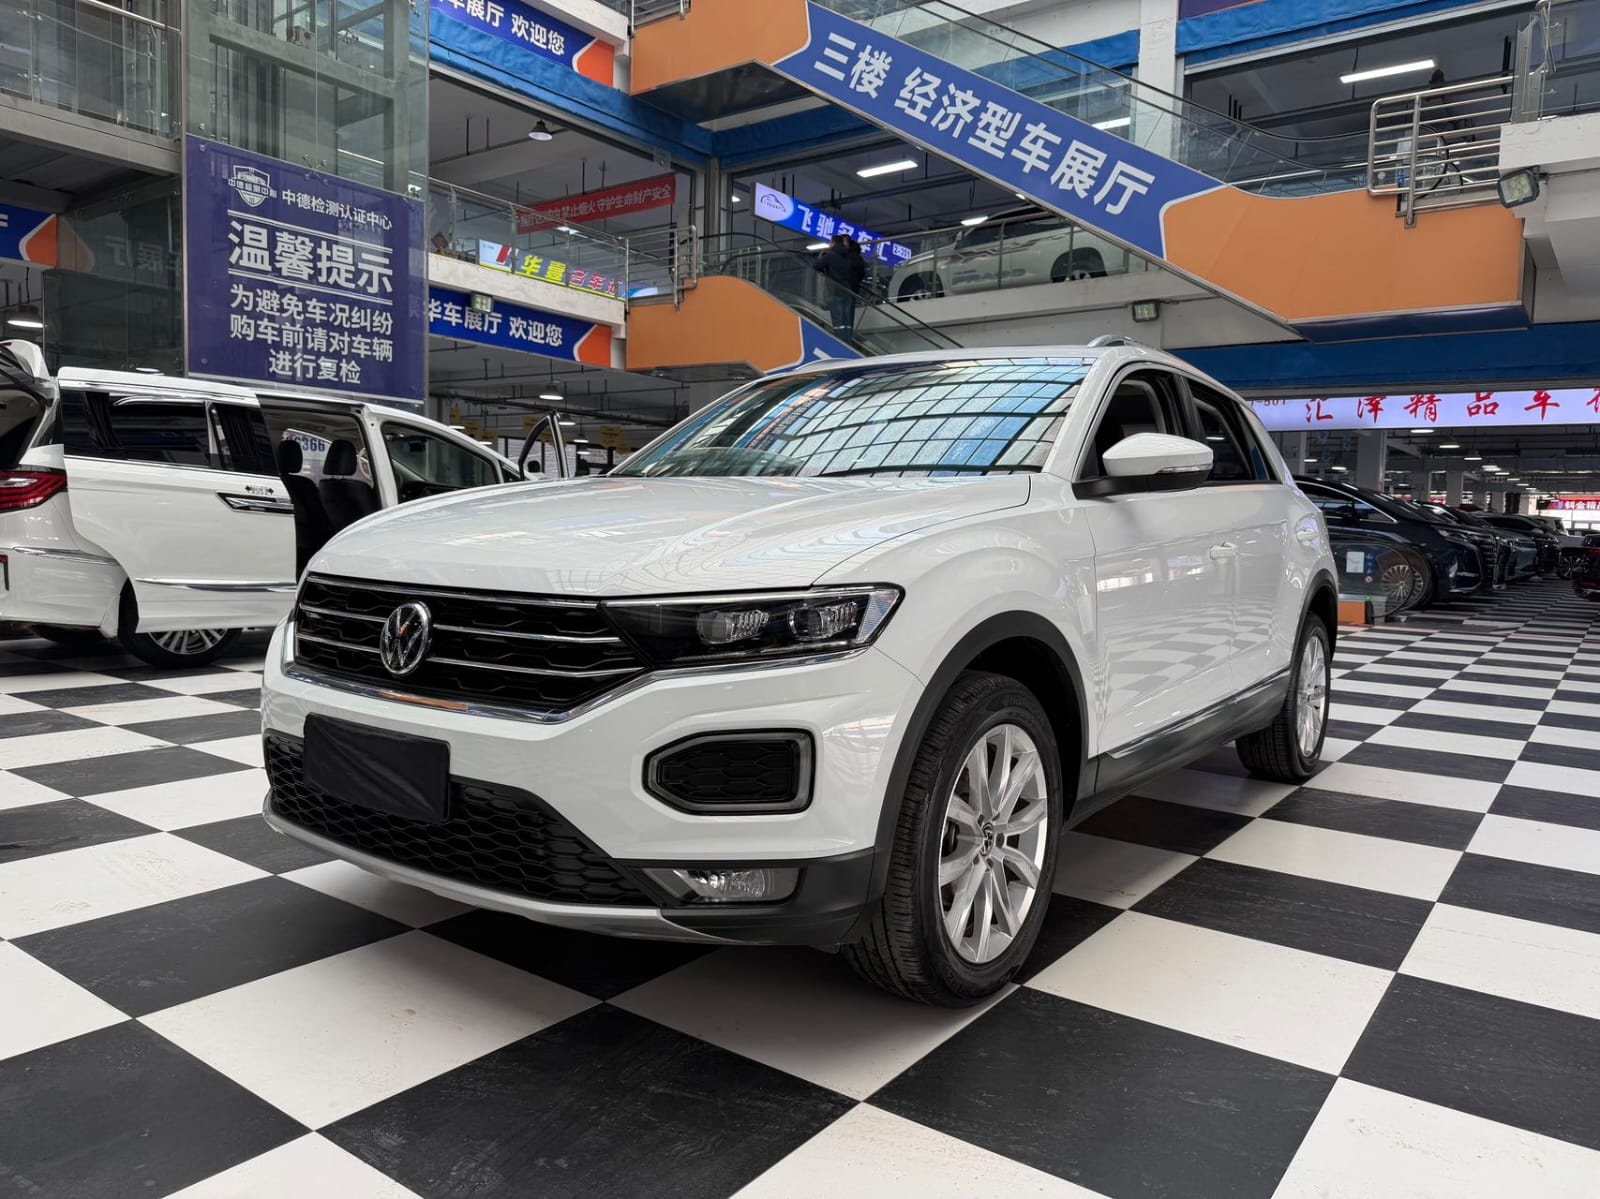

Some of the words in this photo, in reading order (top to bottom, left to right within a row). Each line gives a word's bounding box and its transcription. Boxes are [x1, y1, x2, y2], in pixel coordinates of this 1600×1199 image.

[511, 13, 565, 55] 欢迎您
[814, 32, 892, 99] 三楼
[894, 67, 1155, 215] 经济型车展厅
[282, 189, 392, 230] 中德检测认证中心
[227, 220, 393, 294] 温馨提示
[230, 283, 393, 336] 为避免车况纠纷
[509, 316, 563, 347] 欢迎您
[230, 314, 393, 362] 购车前请对车辆
[268, 349, 361, 384] 进行复检
